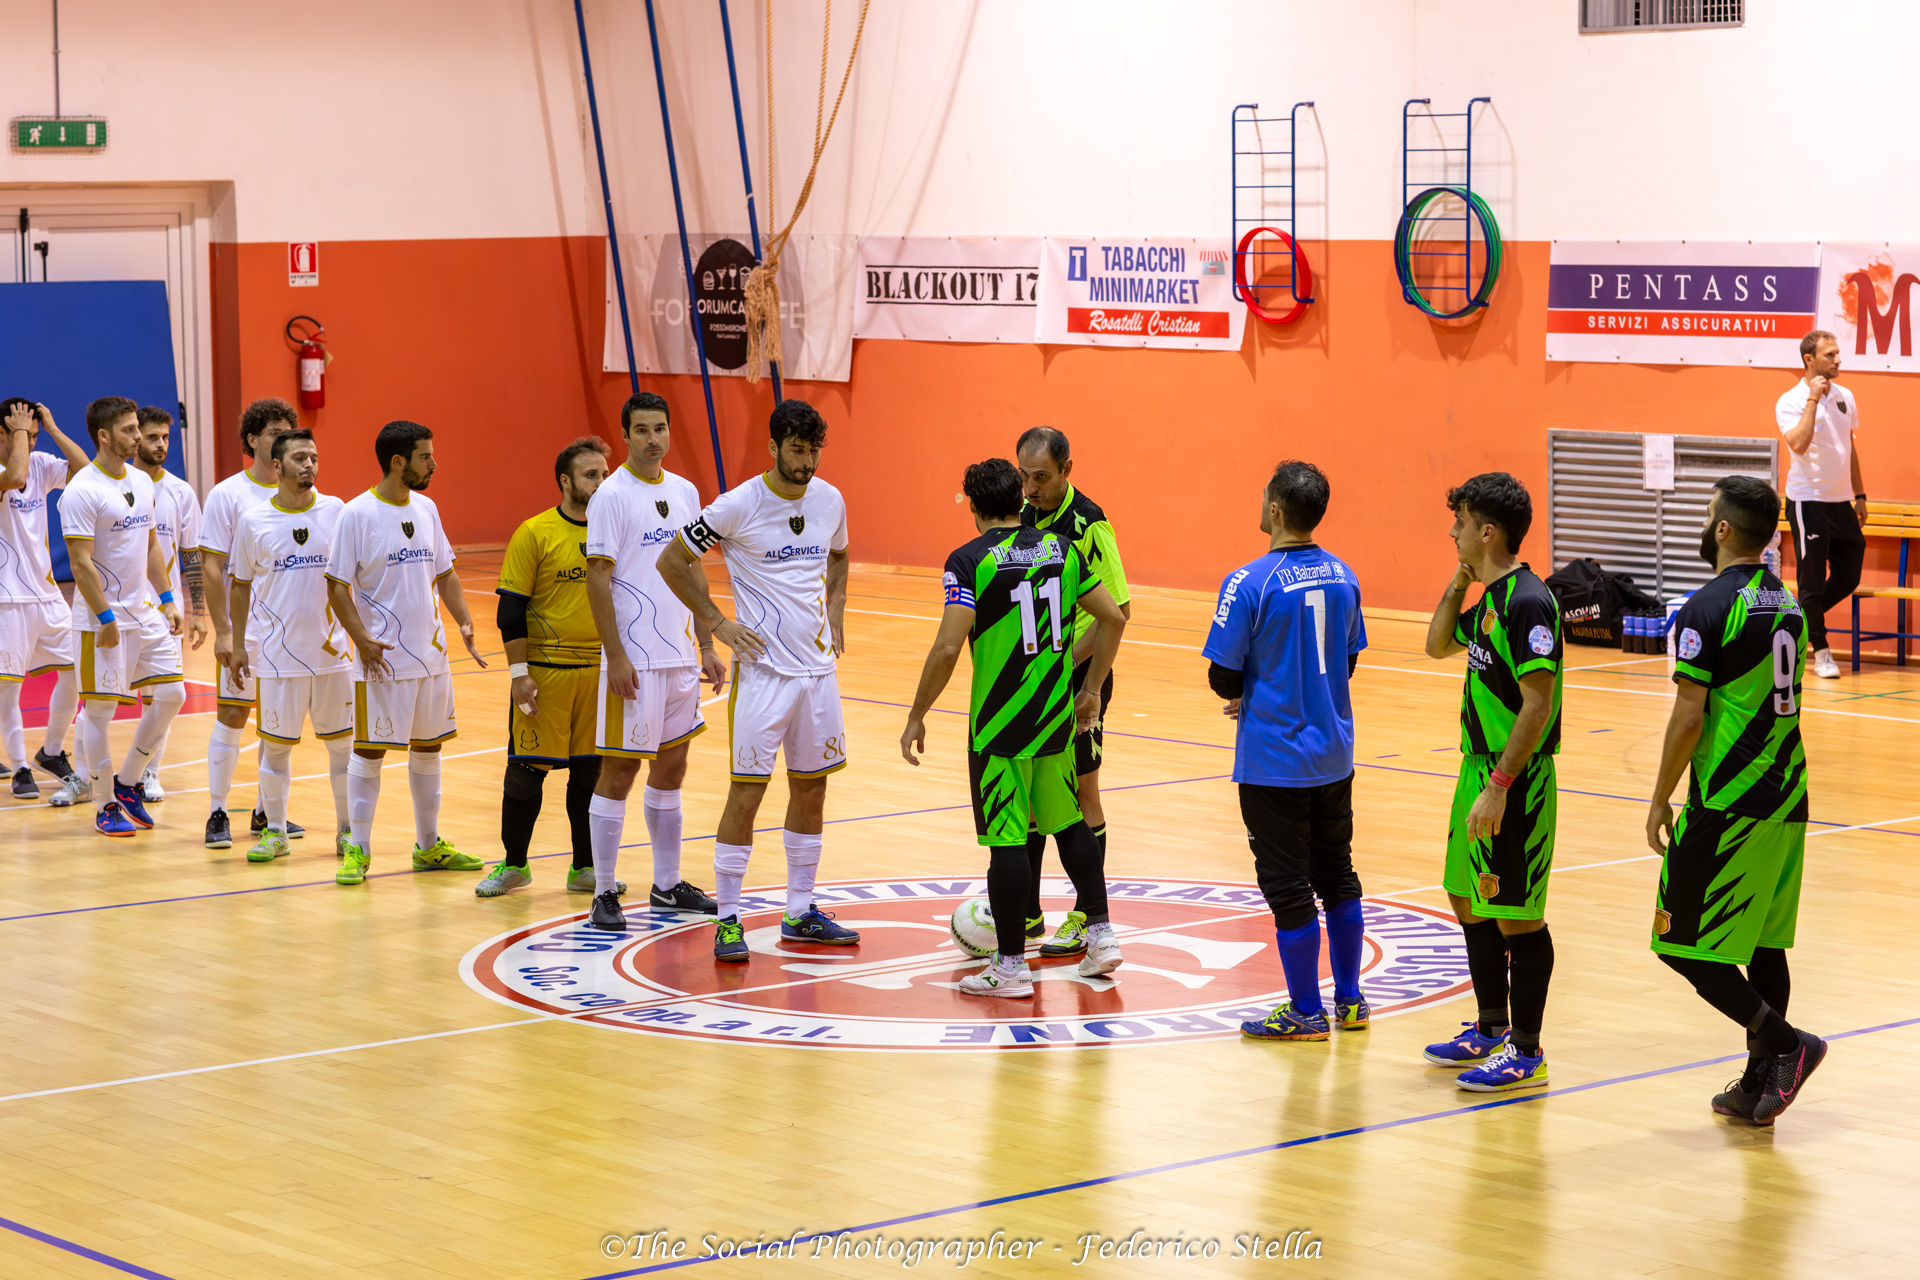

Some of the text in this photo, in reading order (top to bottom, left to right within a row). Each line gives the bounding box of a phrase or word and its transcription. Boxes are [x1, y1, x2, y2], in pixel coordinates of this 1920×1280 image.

[1101, 246, 1186, 273] TABACCHI
[866, 270, 1039, 302] BLACKOUT 17
[1089, 277, 1200, 305] MINIMARKET
[1589, 273, 1778, 302] PENTASS
[1089, 310, 1201, 336] Rosatelli Cristian
[1588, 315, 1777, 333] SERVIZI ASSICURATIVI
[643, 528, 678, 542] ALLSERVI
[274, 554, 324, 568] ALLSERVICE
[765, 545, 820, 560] ALLSERVICE
[556, 567, 587, 580] ALLSER
[1276, 562, 1332, 586] FB Balzanelli
[950, 587, 960, 601] C
[1213, 569, 1250, 628] makay
[1010, 577, 1063, 655] 11
[1305, 589, 1327, 674] 1
[1772, 629, 1797, 716] 9
[823, 732, 846, 760] 80
[518, 965, 581, 992] Soc.
